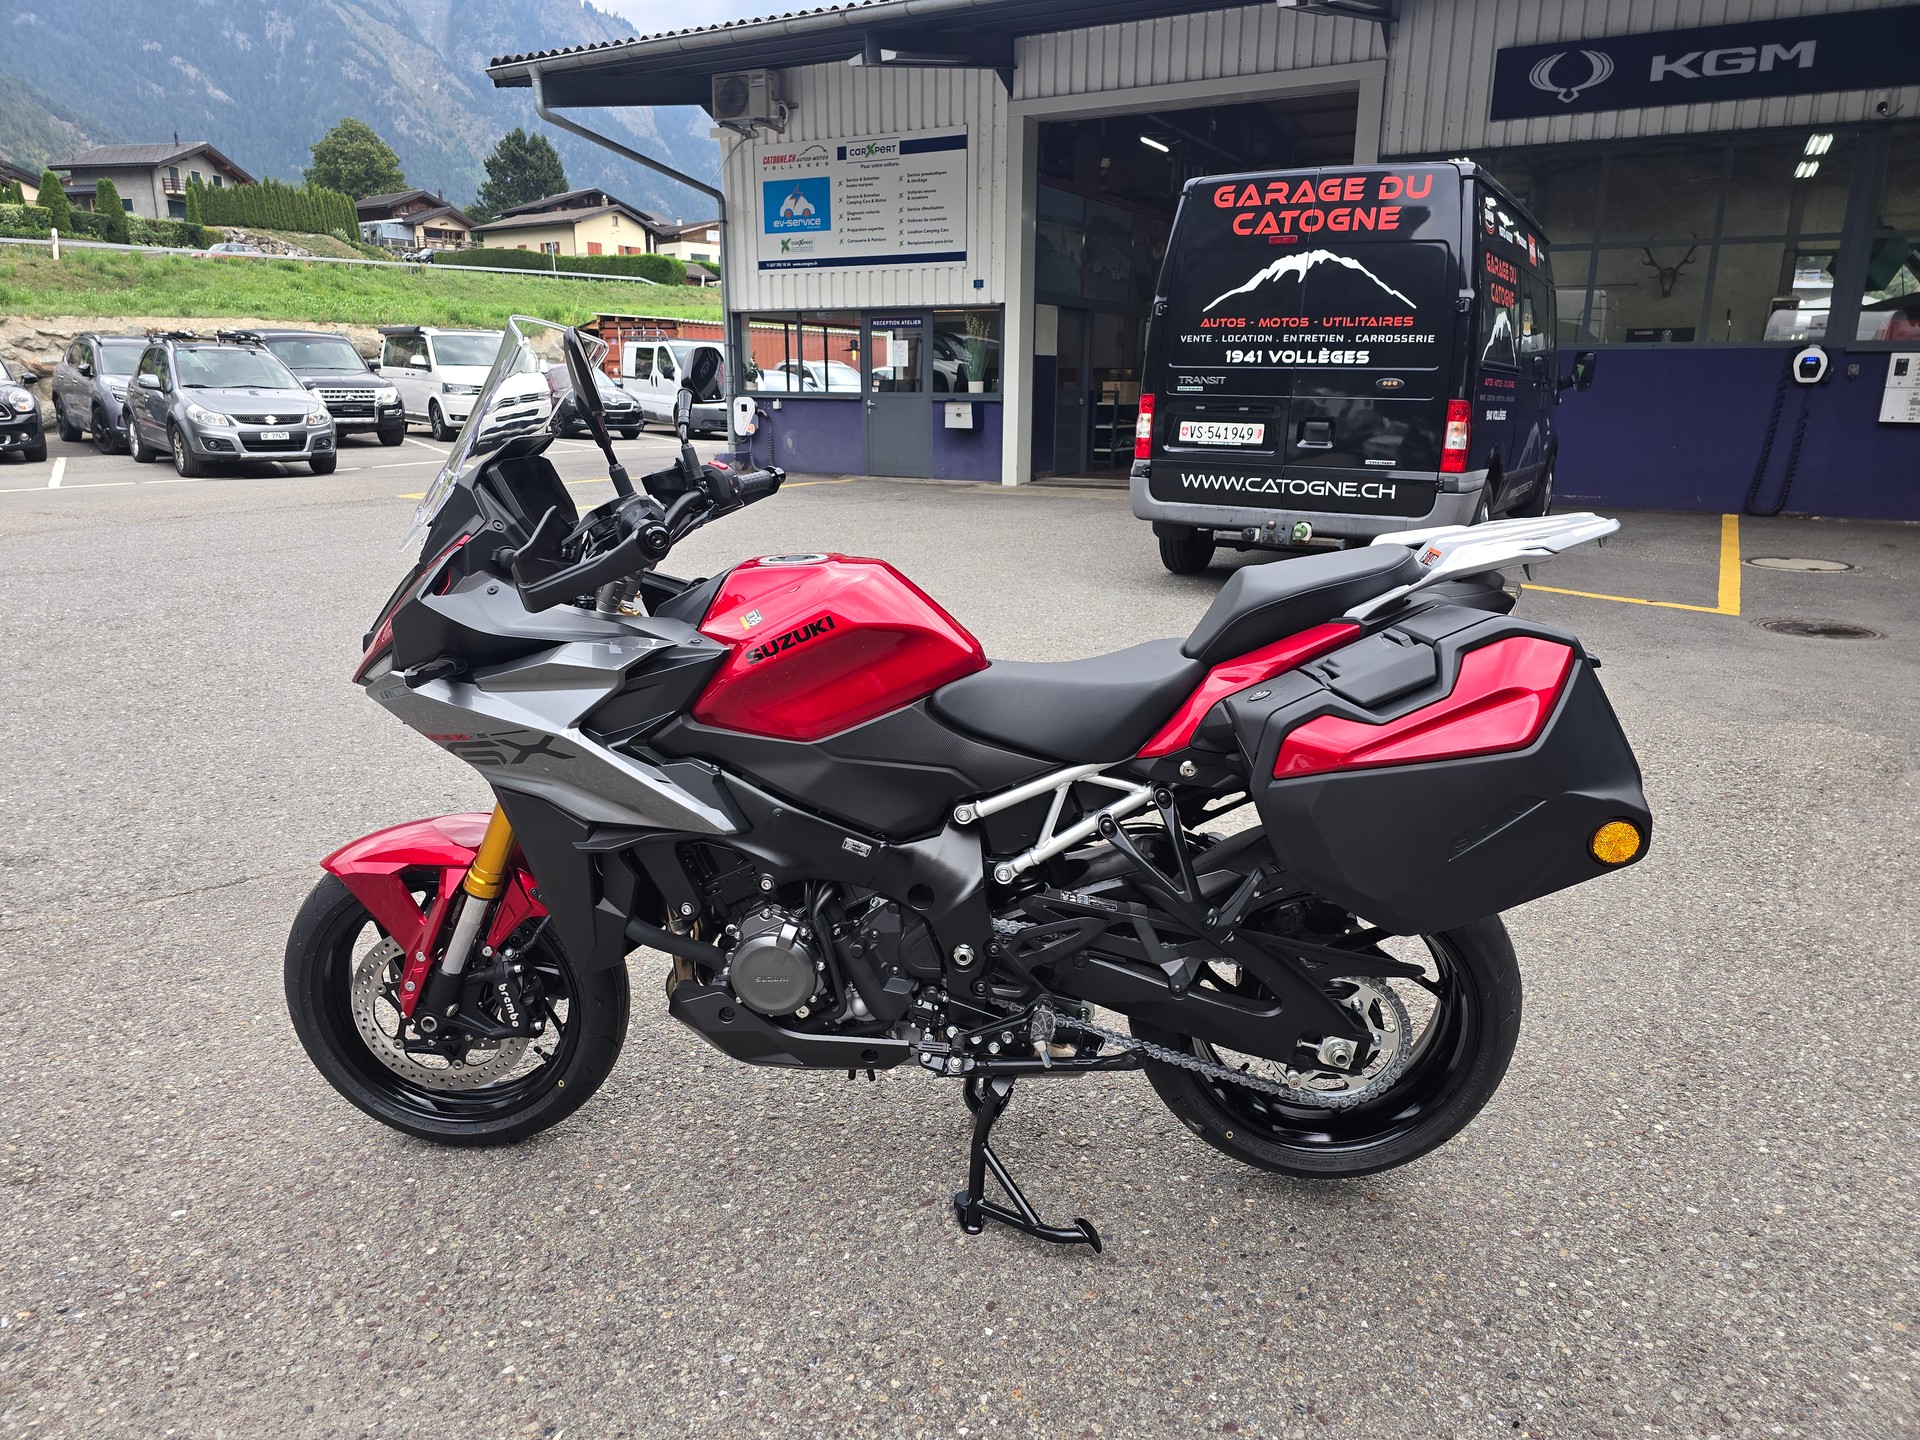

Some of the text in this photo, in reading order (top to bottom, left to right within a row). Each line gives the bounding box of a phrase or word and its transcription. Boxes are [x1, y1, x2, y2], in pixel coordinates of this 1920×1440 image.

[1650, 40, 1817, 82] KGM
[763, 154, 797, 165] CATOGNE.CH
[1214, 174, 1433, 208] GARAGE DU
[773, 217, 821, 227] ev-service
[1232, 206, 1402, 236] CATOGNE
[1200, 317, 1246, 328] AUTOS
[1258, 317, 1309, 328] MOTOS
[1323, 316, 1414, 327] UTILITAIRES
[1180, 334, 1213, 343] VENTE
[1222, 334, 1273, 343] LOCATION
[1283, 334, 1344, 343] ENTRETIEN
[1355, 334, 1435, 343] CARROSSERIE
[1226, 347, 1370, 364] 1941 VOLLÈGES
[1178, 375, 1226, 384] TRANSIT
[1181, 473, 1396, 499] WWW.CATOGNE.CH
[745, 615, 836, 665] SUZUKI
[498, 983, 520, 1028] brembo
